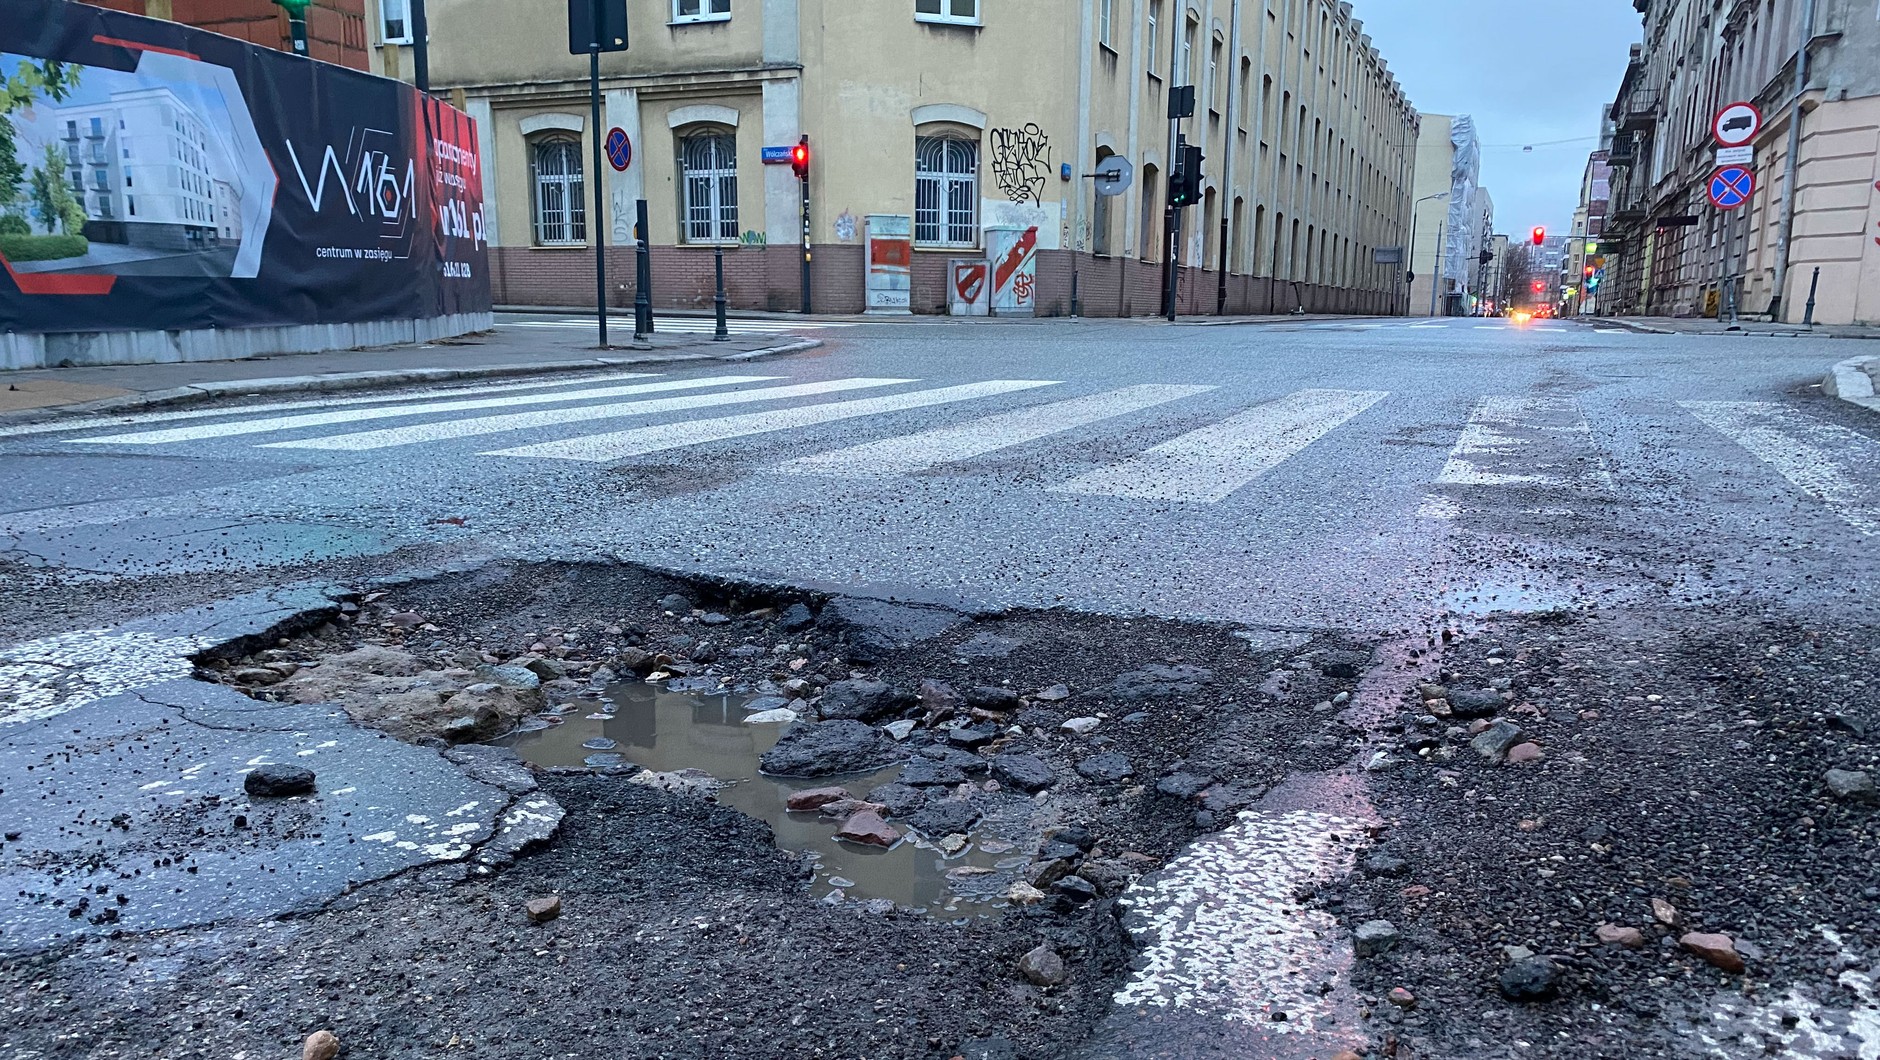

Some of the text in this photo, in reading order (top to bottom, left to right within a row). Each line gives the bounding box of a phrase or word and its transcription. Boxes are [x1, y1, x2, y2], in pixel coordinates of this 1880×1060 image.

[765, 150, 793, 158] Wólczańsk
[316, 246, 393, 262] centrum w zasięgu
